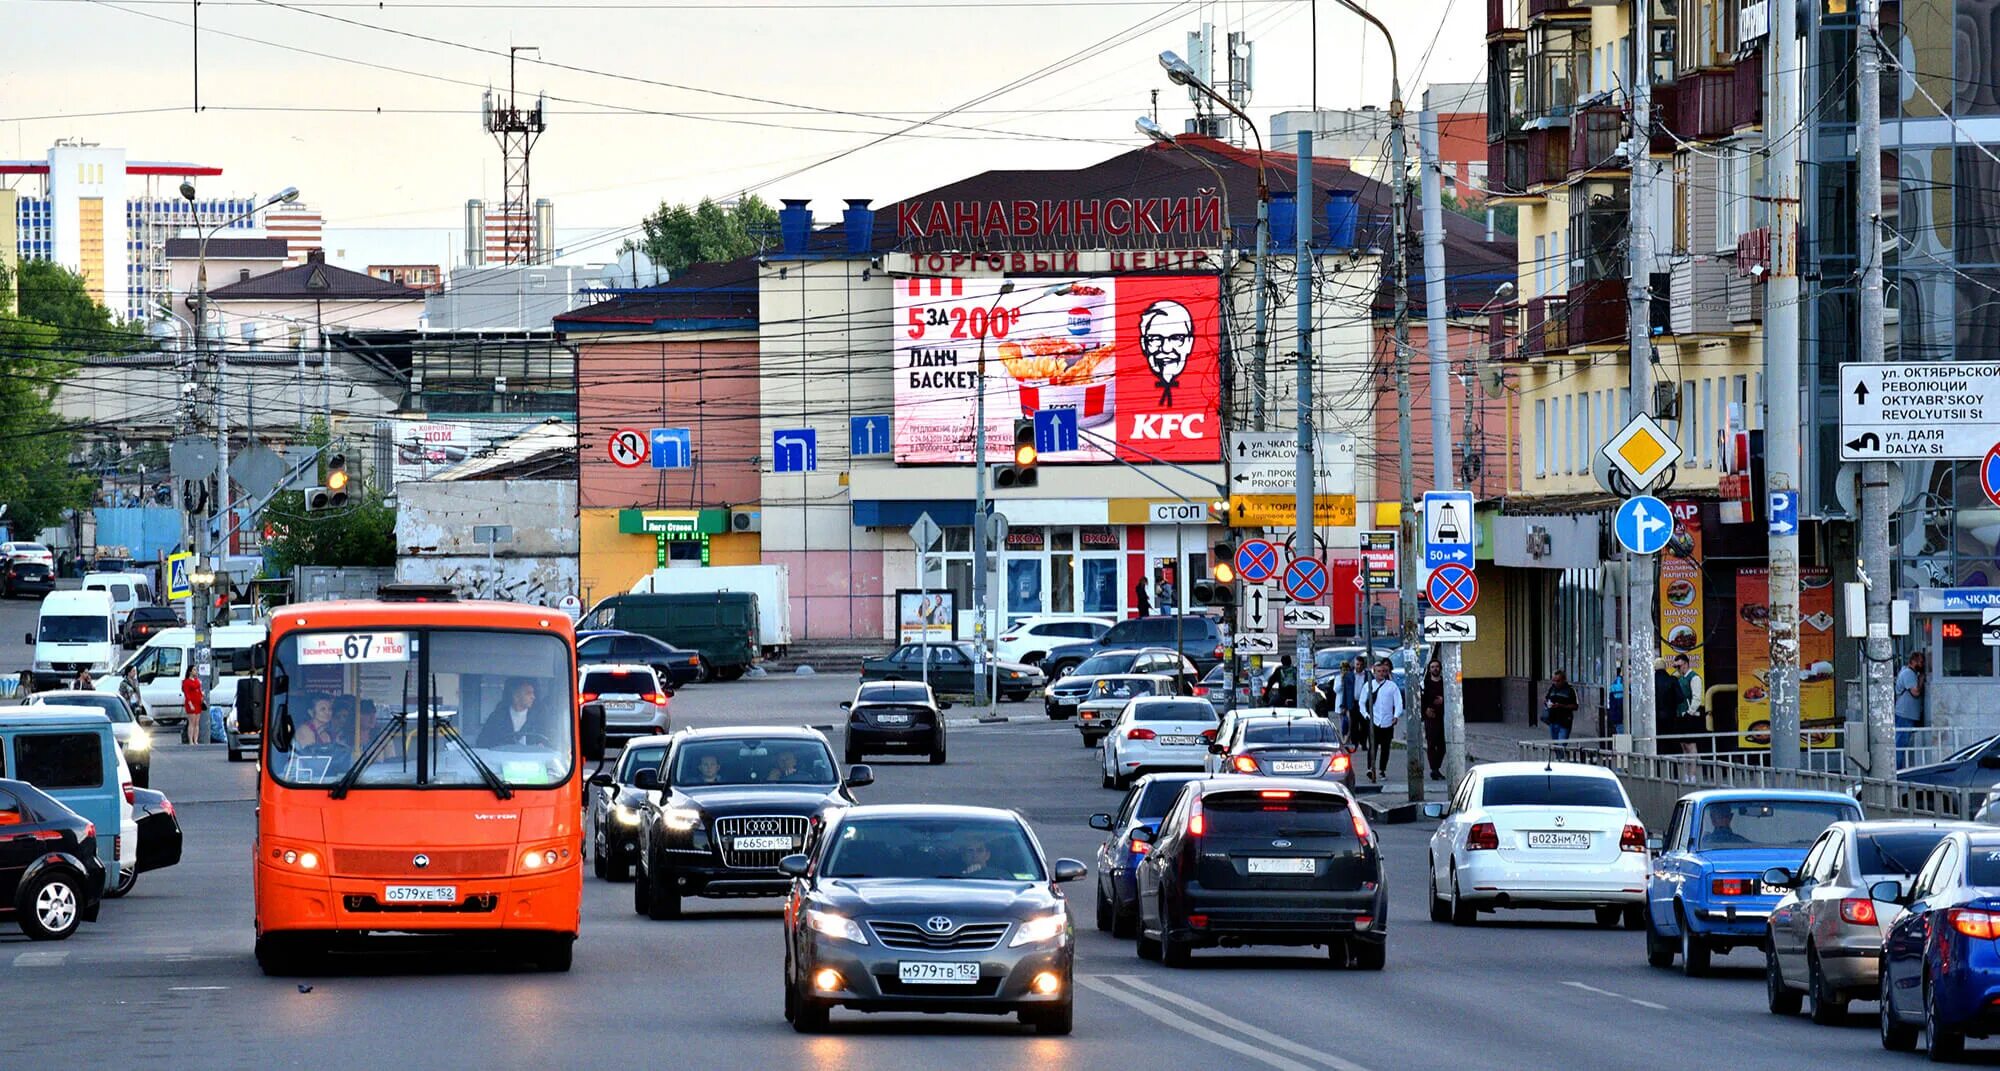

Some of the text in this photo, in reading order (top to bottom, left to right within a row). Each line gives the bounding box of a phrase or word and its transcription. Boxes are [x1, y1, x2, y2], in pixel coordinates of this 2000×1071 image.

[897, 187, 1220, 238] КАНАВИНСКИЙ
[910, 251, 1208, 273] ТОРГОВЫЙ ЦЕНТР
[909, 350, 958, 368] ЛАНЧ
[910, 371, 978, 389] БАСКЕТ
[1882, 370, 1900, 380] ул.
[1882, 381, 1968, 392] РЕВОЛЮЦИИ
[1882, 408, 1983, 420] REVOLYUTSII St
[1130, 413, 1205, 440] KFC
[424, 431, 452, 443] ДОМ
[1886, 430, 1944, 442] ул. ДАЛЯ
[1251, 441, 1265, 450] ул.
[1340, 444, 1354, 453] 0,2
[1886, 444, 1943, 455] DALYA St
[1251, 471, 1265, 479] ул.
[1158, 505, 1200, 519] СТОП
[1007, 534, 1043, 544] ВХОД
[1082, 533, 1119, 544] ВХОД
[1430, 551, 1443, 560] 50
[1947, 597, 1963, 607] ул.
[1663, 607, 1699, 617] ШАУРМА
[344, 634, 373, 659] 67
[775, 837, 790, 846] 152
[436, 887, 453, 898] 152
[902, 964, 977, 978] М979ТВ 152
